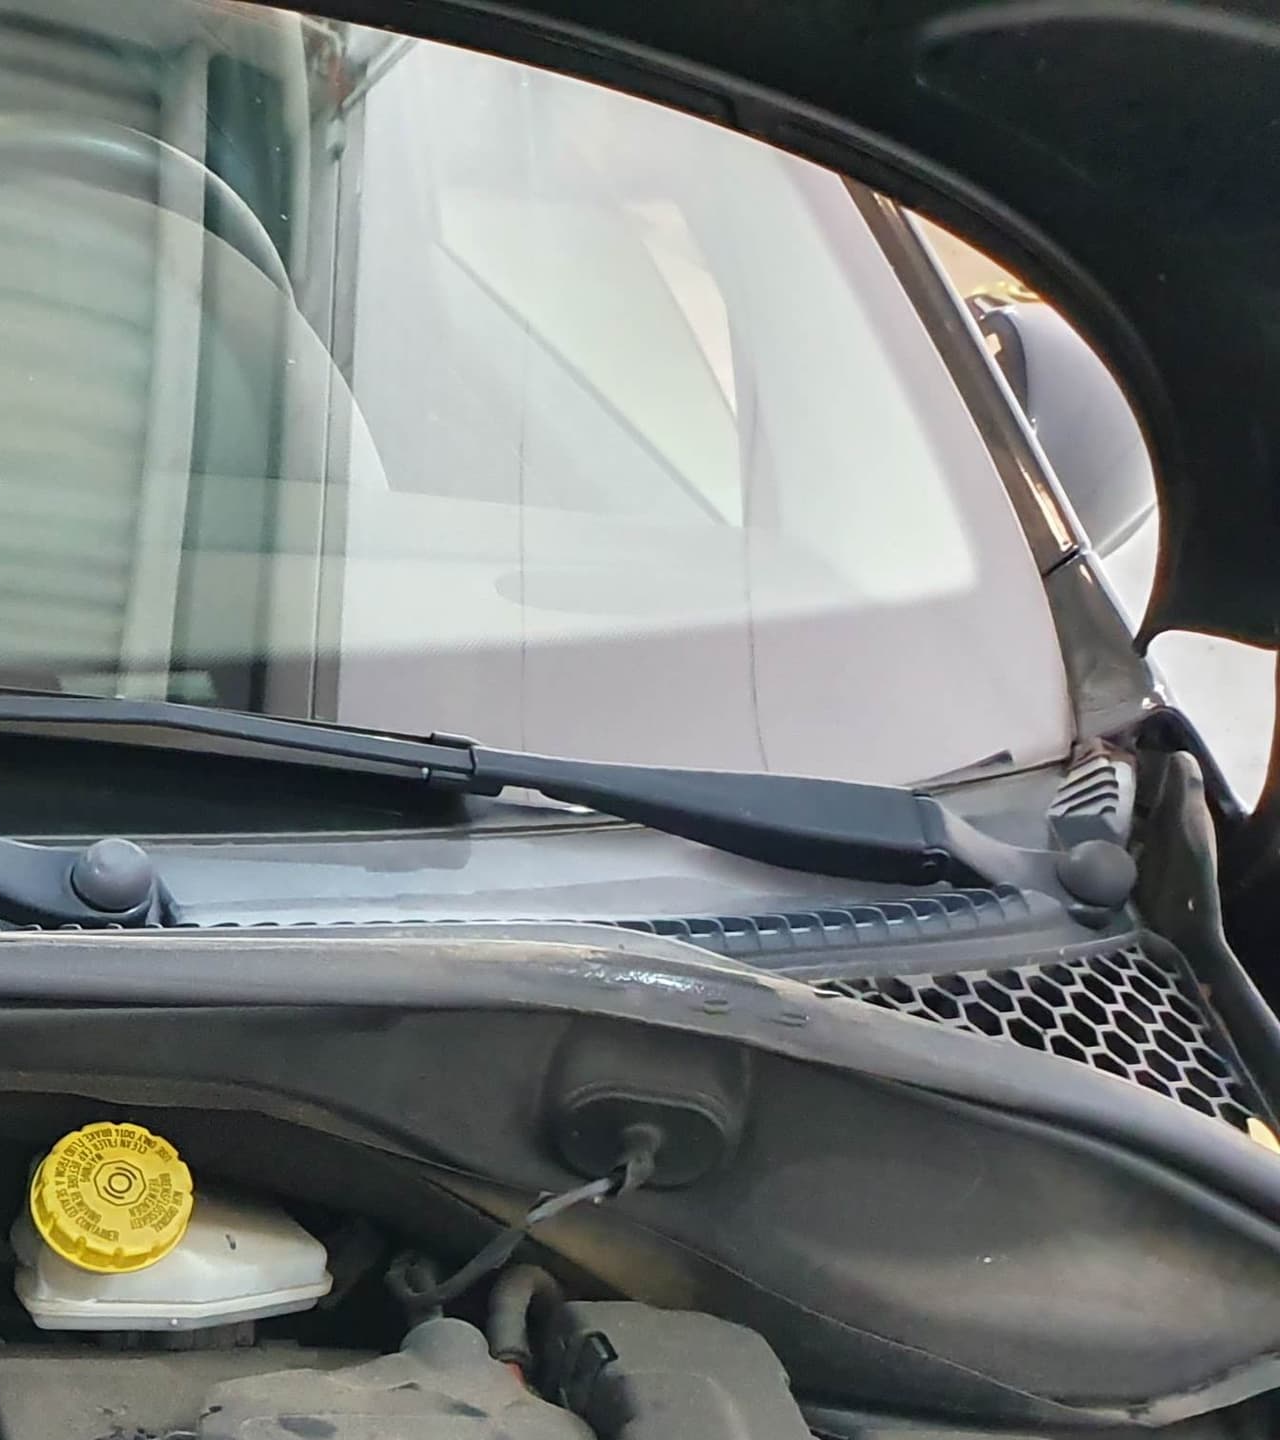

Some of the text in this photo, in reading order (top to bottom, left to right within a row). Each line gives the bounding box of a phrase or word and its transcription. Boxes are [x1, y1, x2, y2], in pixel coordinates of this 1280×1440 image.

[83, 1128, 113, 1143] BRAKE
[91, 1138, 118, 1152] FILLER
[64, 1138, 85, 1157] FLUID
[78, 1144, 94, 1162] CAP
[120, 1139, 148, 1154] CLEAN
[55, 1156, 71, 1178] FROM
[67, 1160, 81, 1189] BEFORE
[55, 1188, 78, 1218] SEALED
[75, 1216, 119, 1242] CONTAINER
